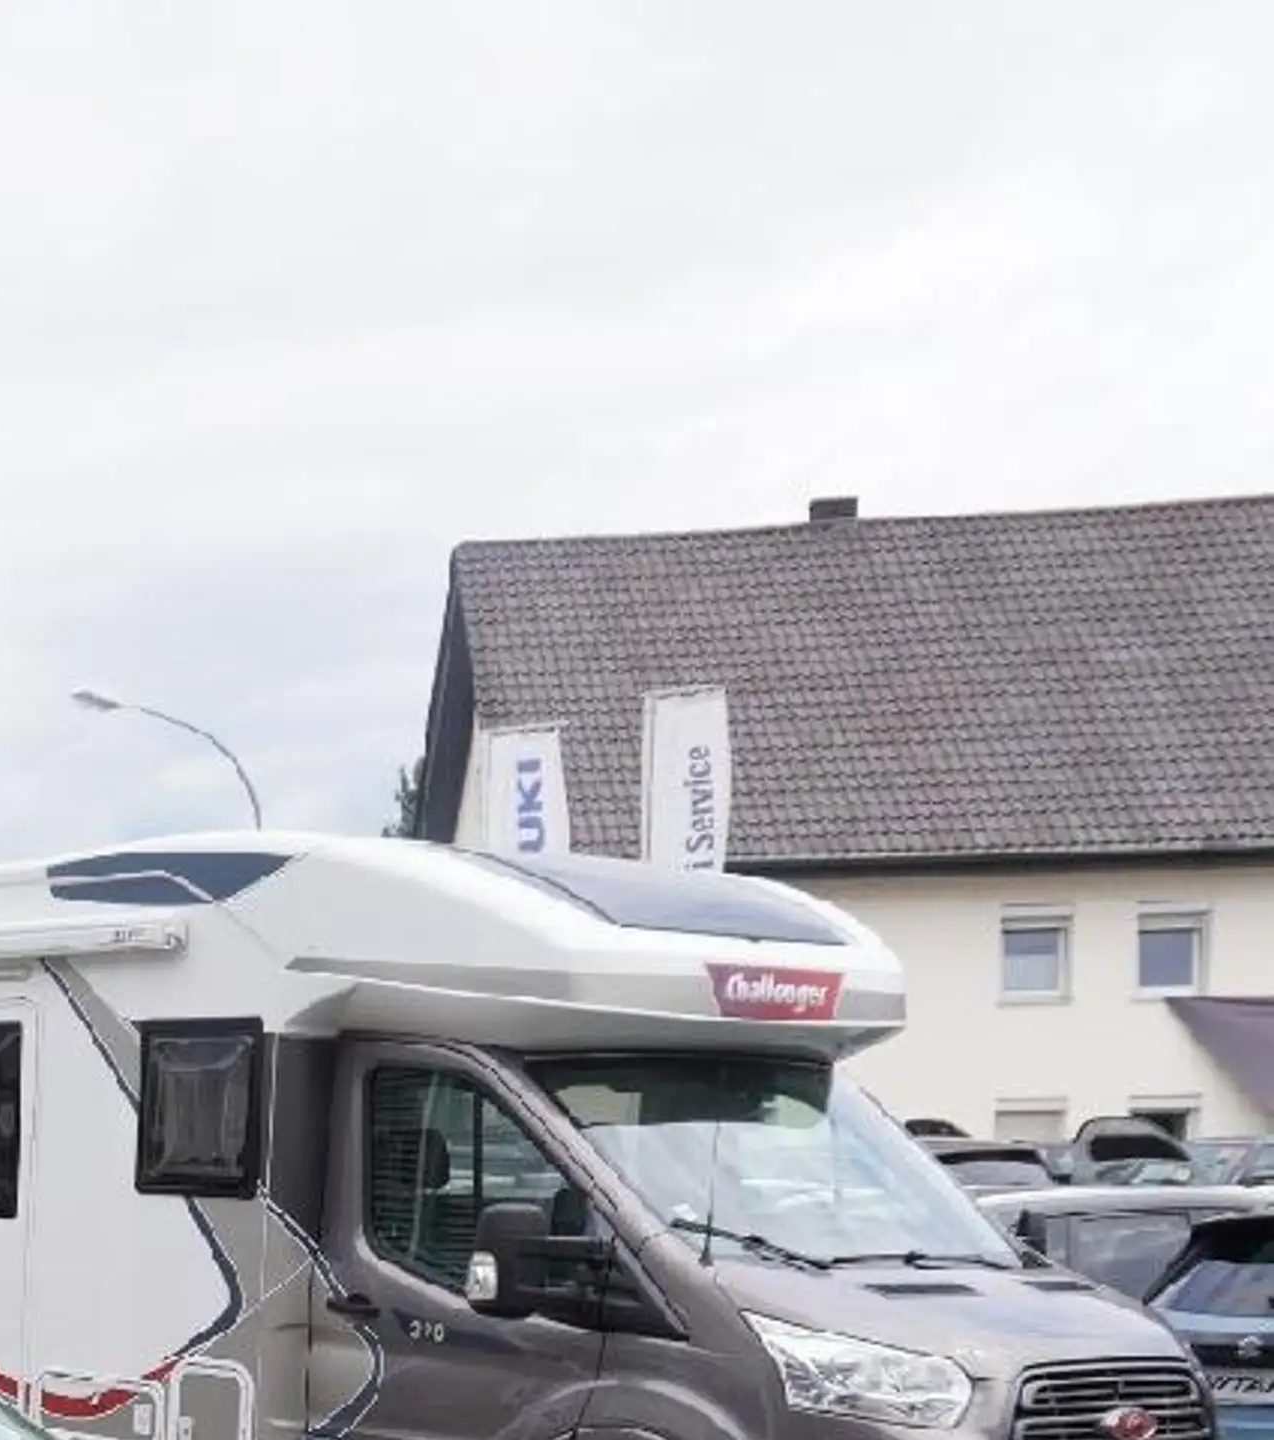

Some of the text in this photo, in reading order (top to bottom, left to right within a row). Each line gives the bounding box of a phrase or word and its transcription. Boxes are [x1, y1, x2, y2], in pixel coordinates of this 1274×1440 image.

[516, 757, 545, 853] UKI
[683, 744, 715, 853] Service
[725, 972, 830, 1014] Challenger
